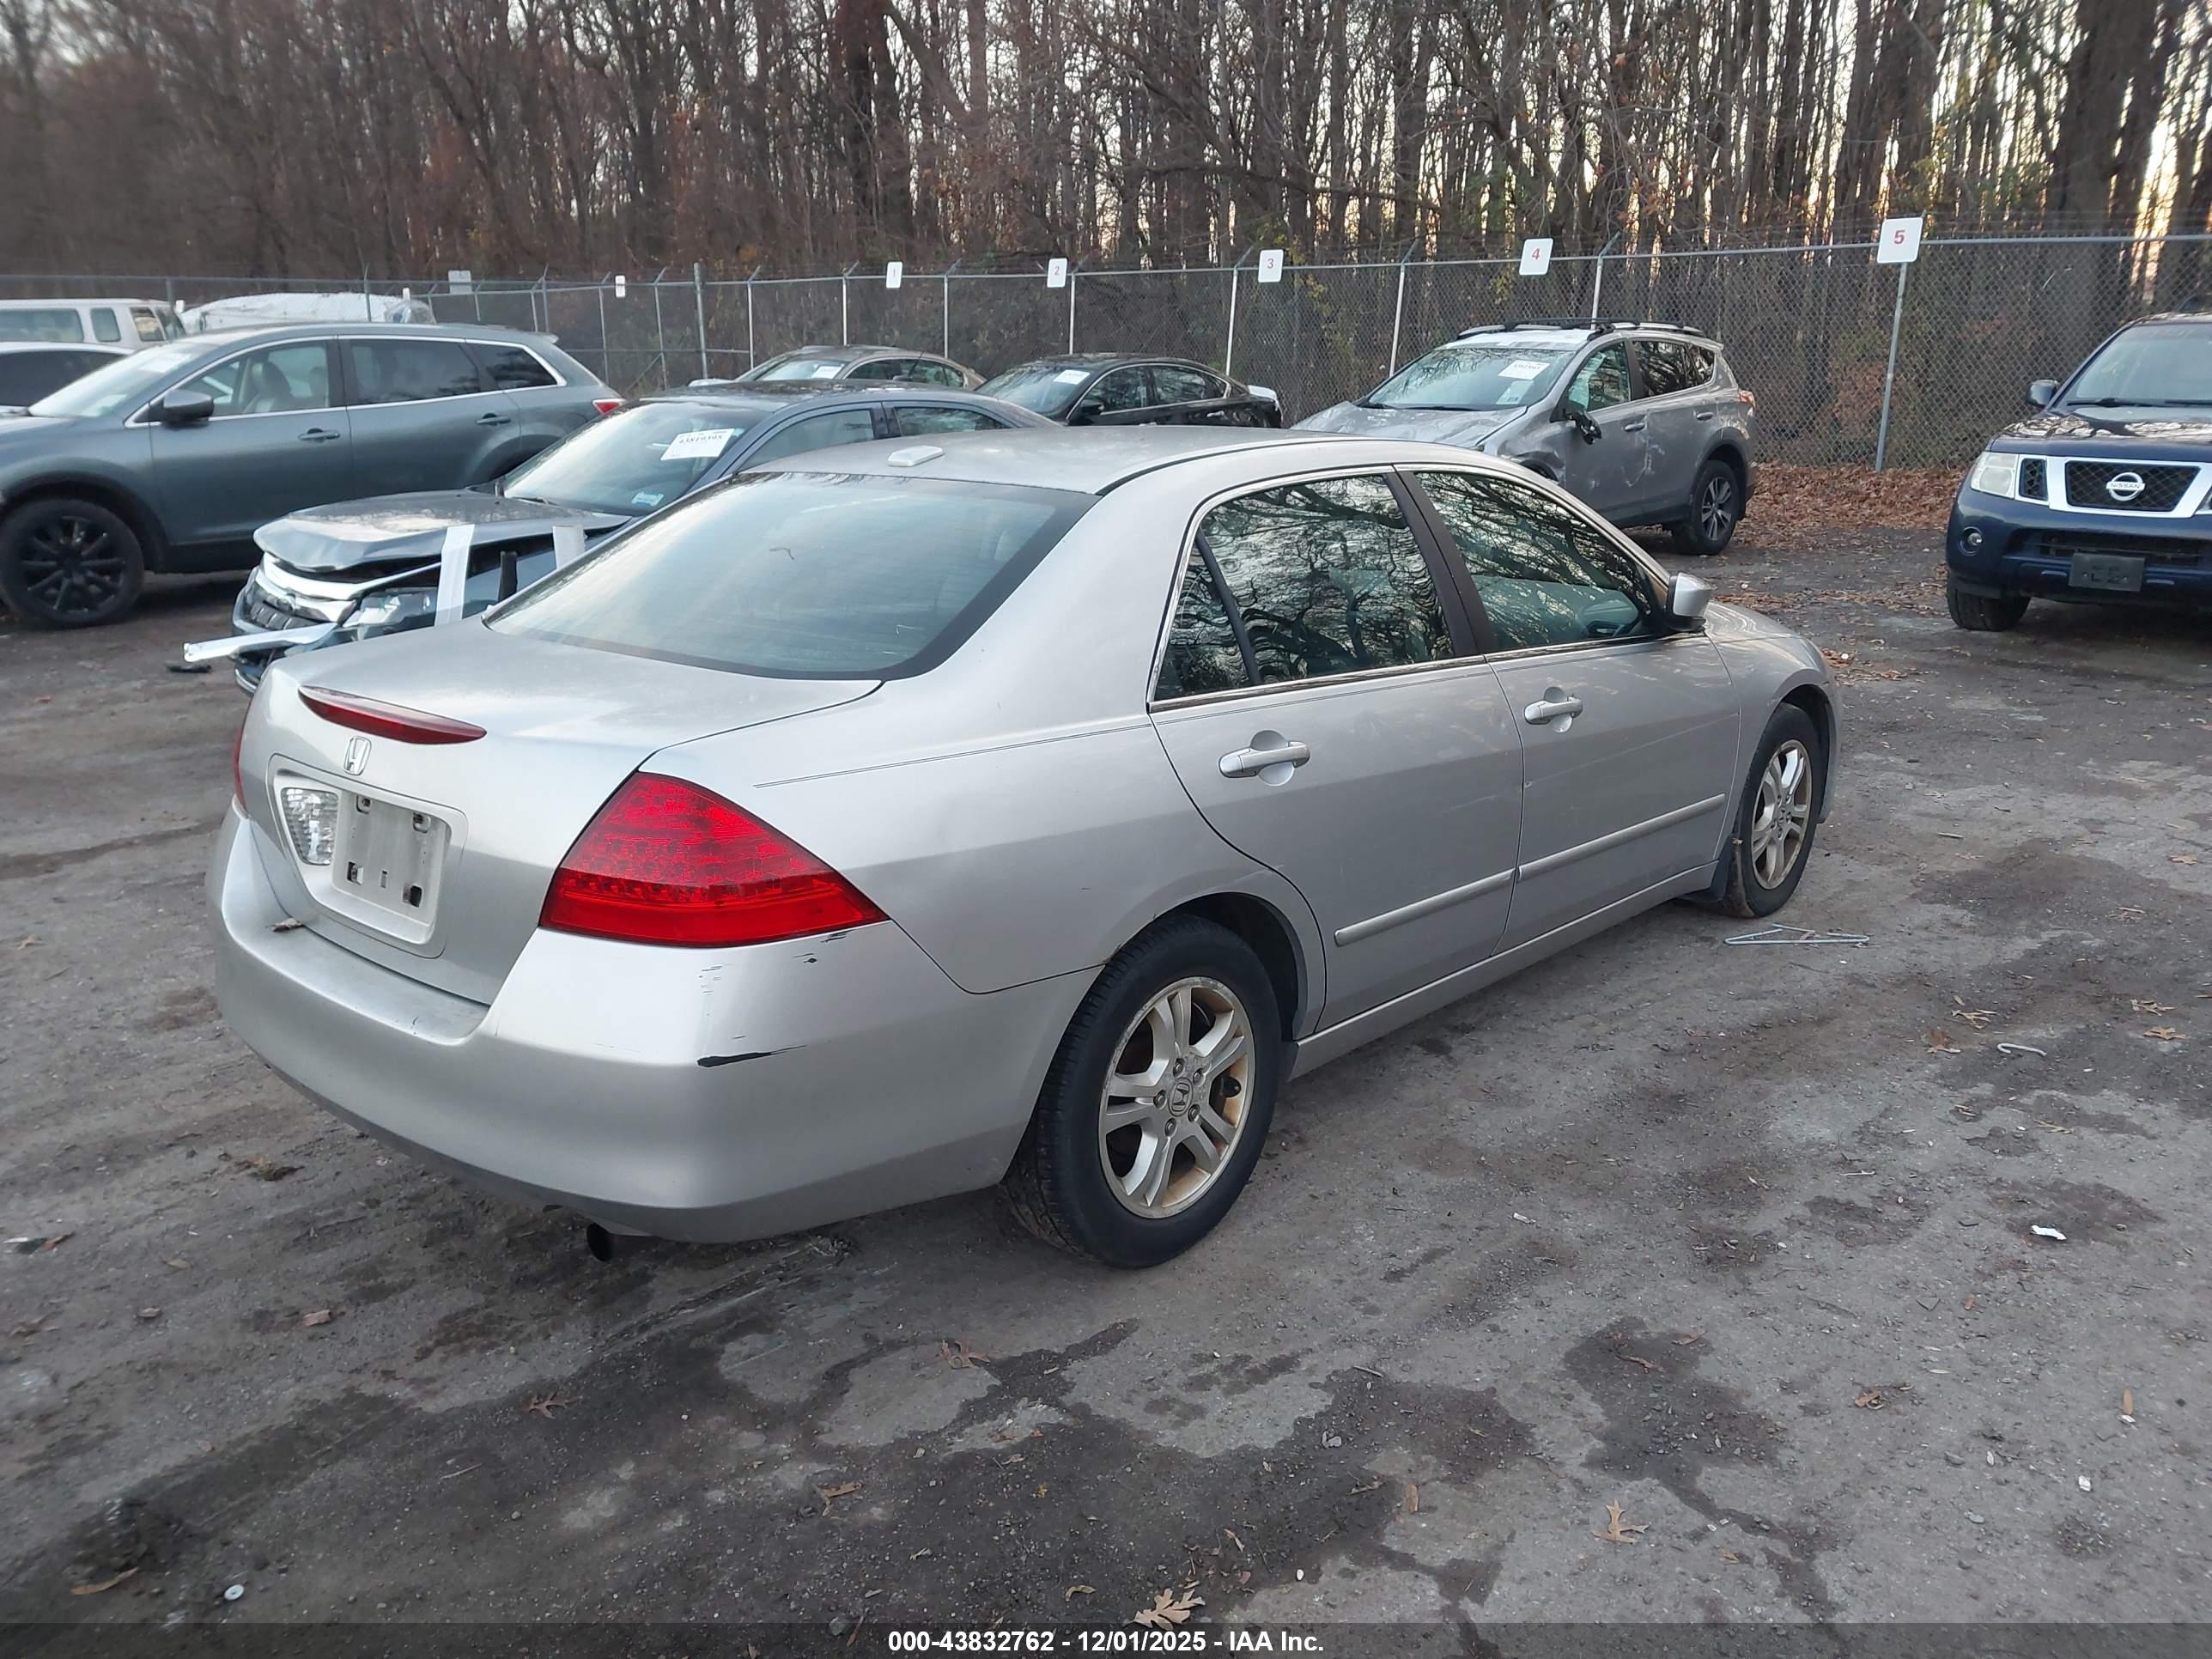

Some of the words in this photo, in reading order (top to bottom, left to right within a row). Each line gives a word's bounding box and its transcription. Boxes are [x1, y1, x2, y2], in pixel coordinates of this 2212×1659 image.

[1894, 229, 1905, 244] 5
[1531, 248, 1540, 259] 4
[1267, 258, 1274, 269] 3
[1054, 265, 1060, 276] 2
